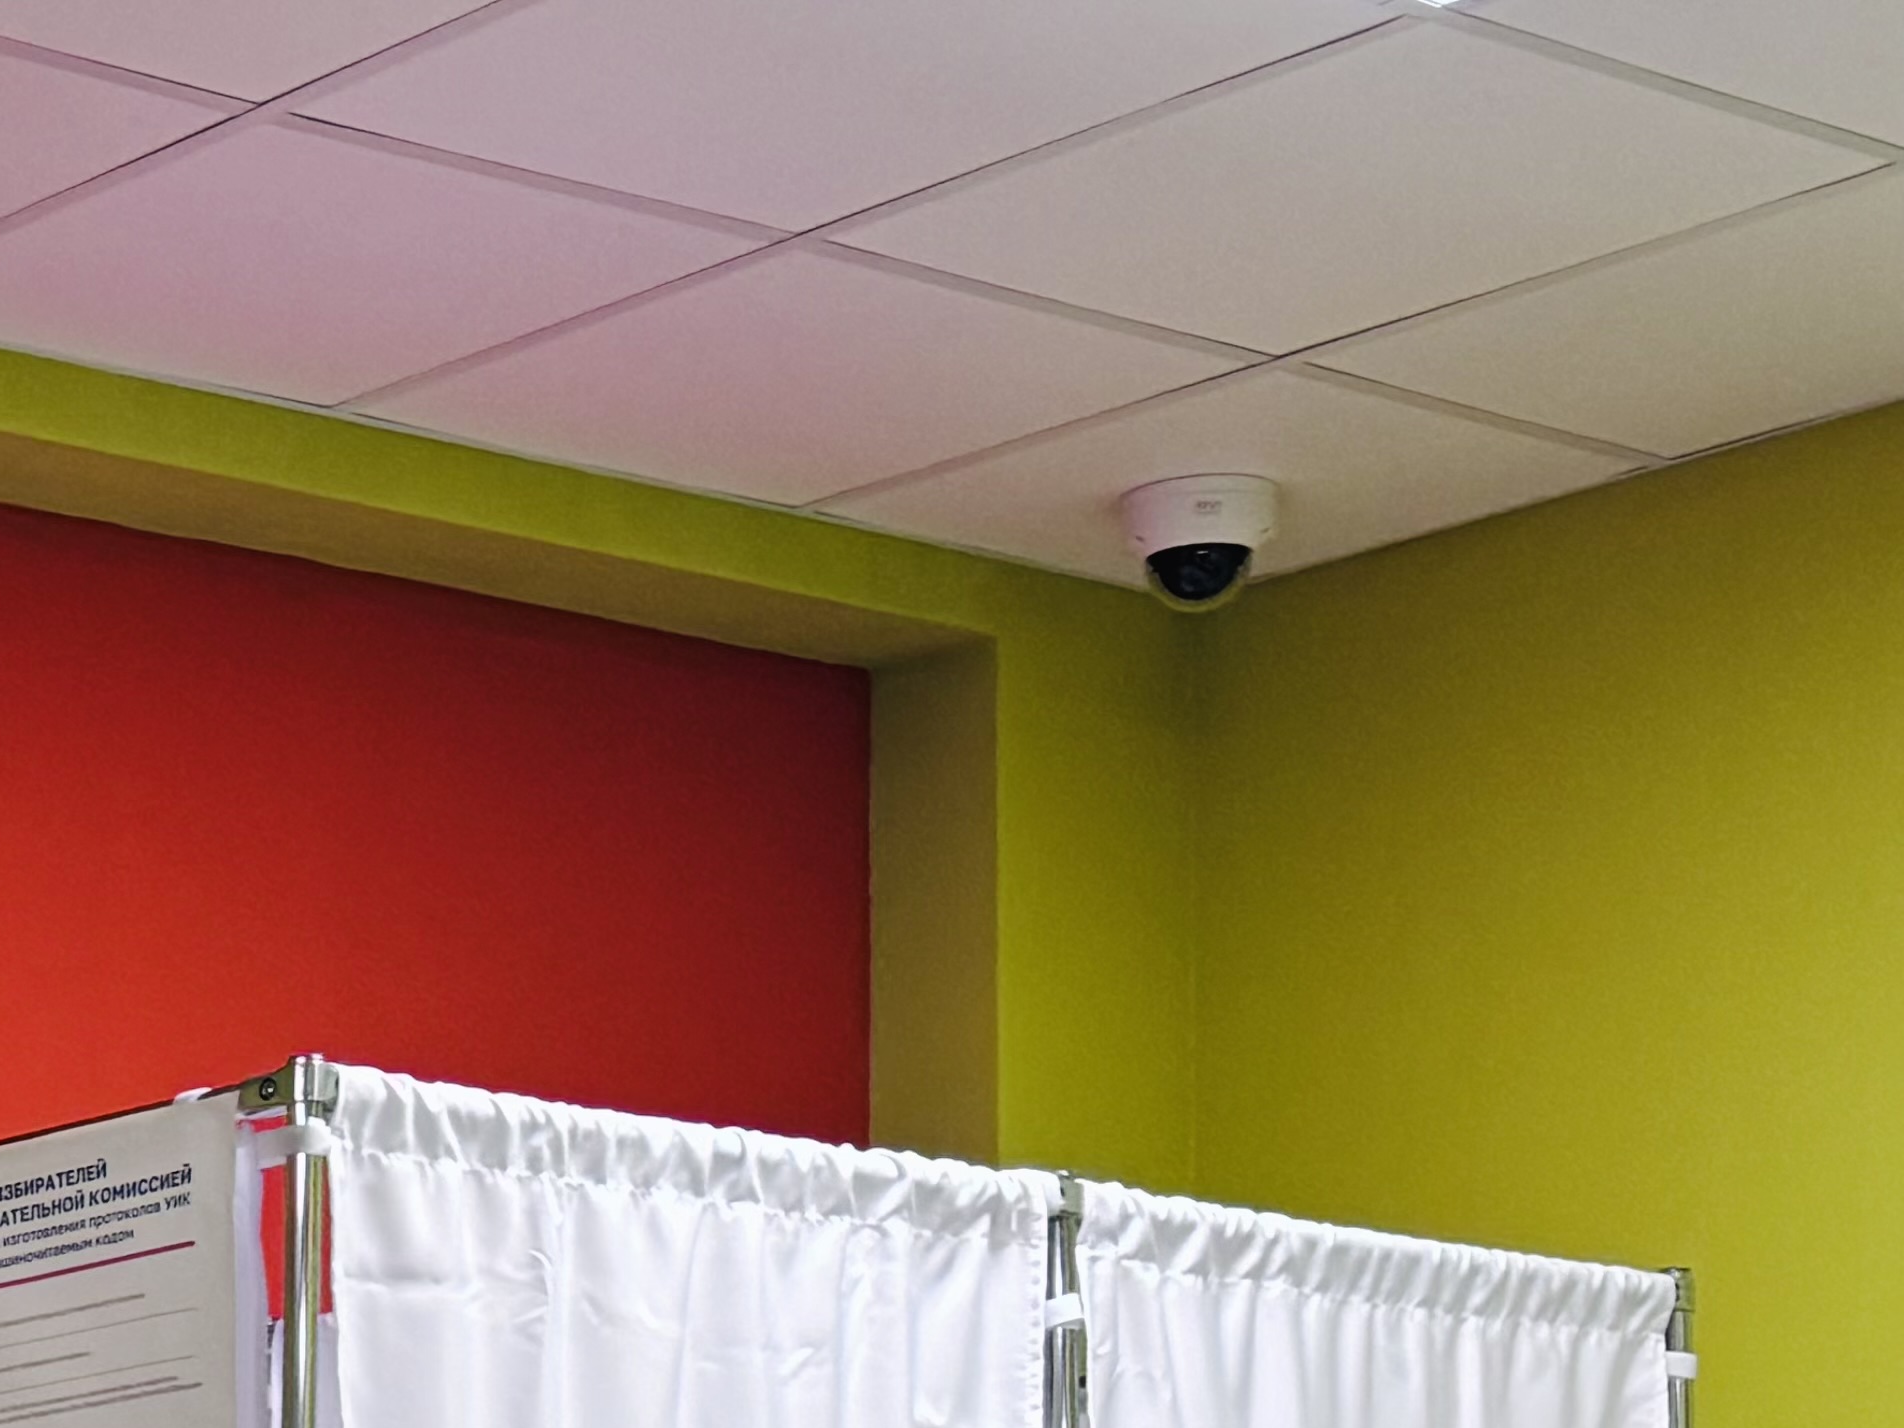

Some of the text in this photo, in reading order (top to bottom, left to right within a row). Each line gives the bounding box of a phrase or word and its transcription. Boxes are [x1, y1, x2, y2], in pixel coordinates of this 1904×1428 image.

[89, 1163, 192, 1207] КОМИССИЕЙ
[3, 1219, 86, 1247] изготовления
[89, 1202, 161, 1229] протоколов
